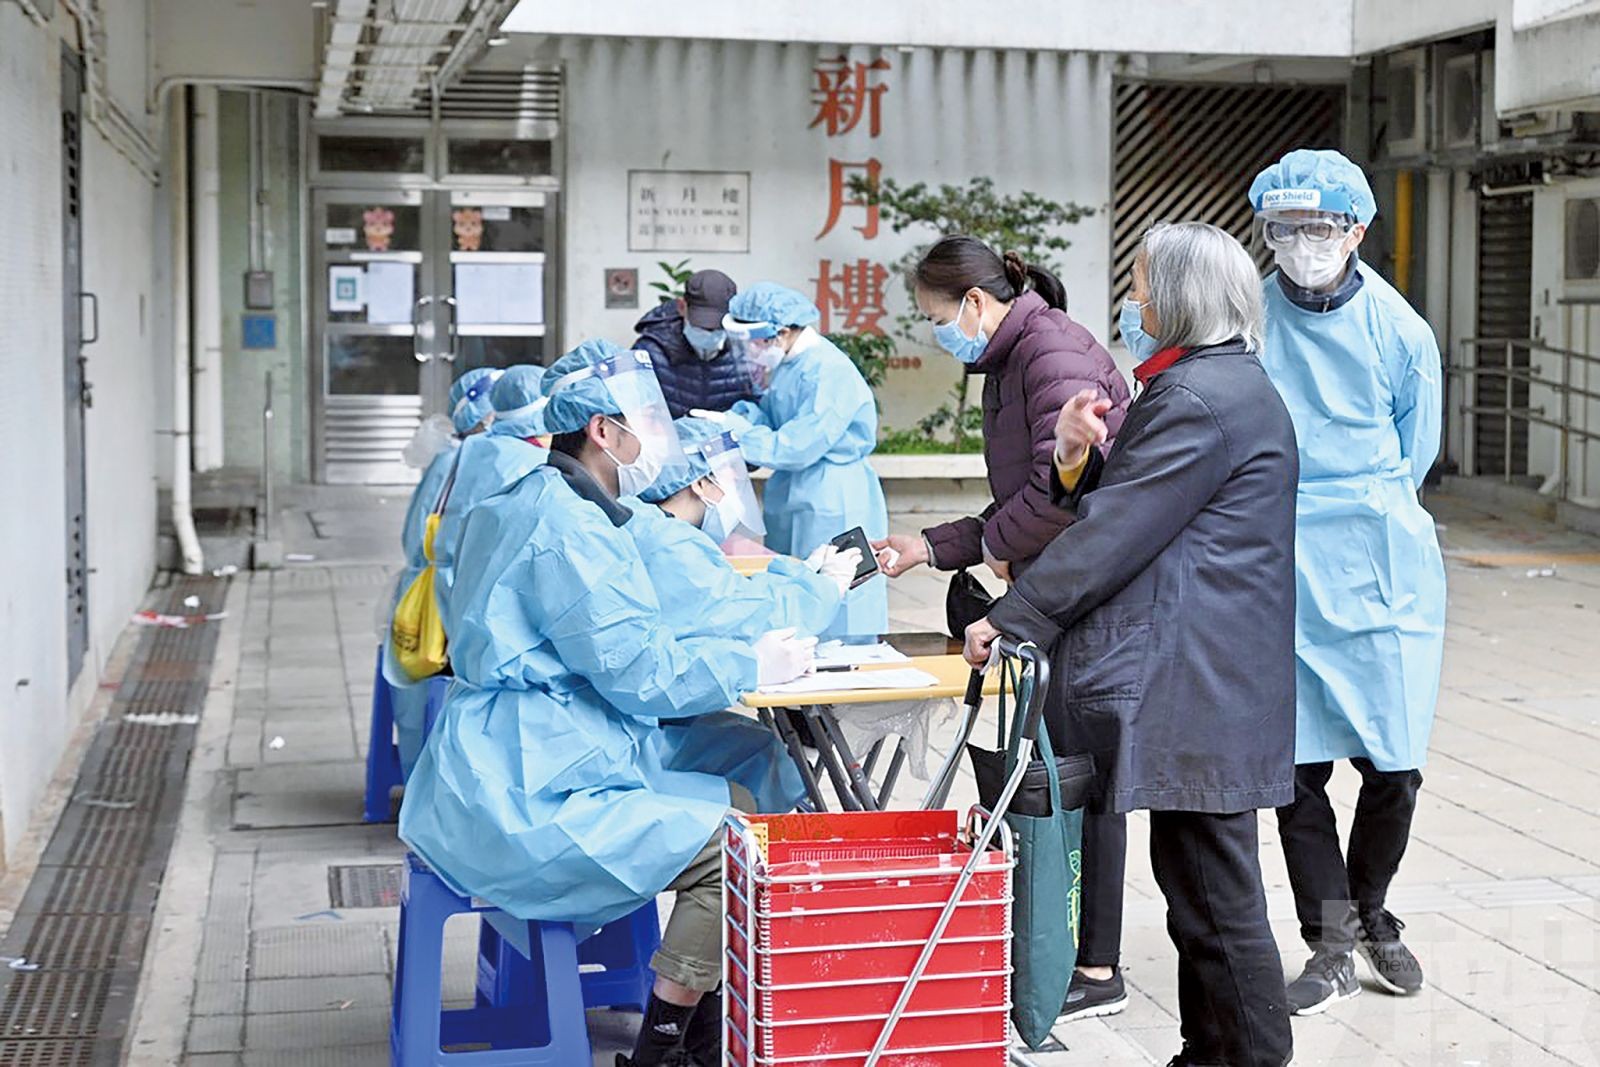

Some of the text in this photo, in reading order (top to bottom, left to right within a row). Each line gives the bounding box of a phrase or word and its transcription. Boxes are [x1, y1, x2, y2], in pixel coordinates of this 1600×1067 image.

[807, 53, 891, 338] 新月樓
[1282, 191, 1313, 201] Shield
